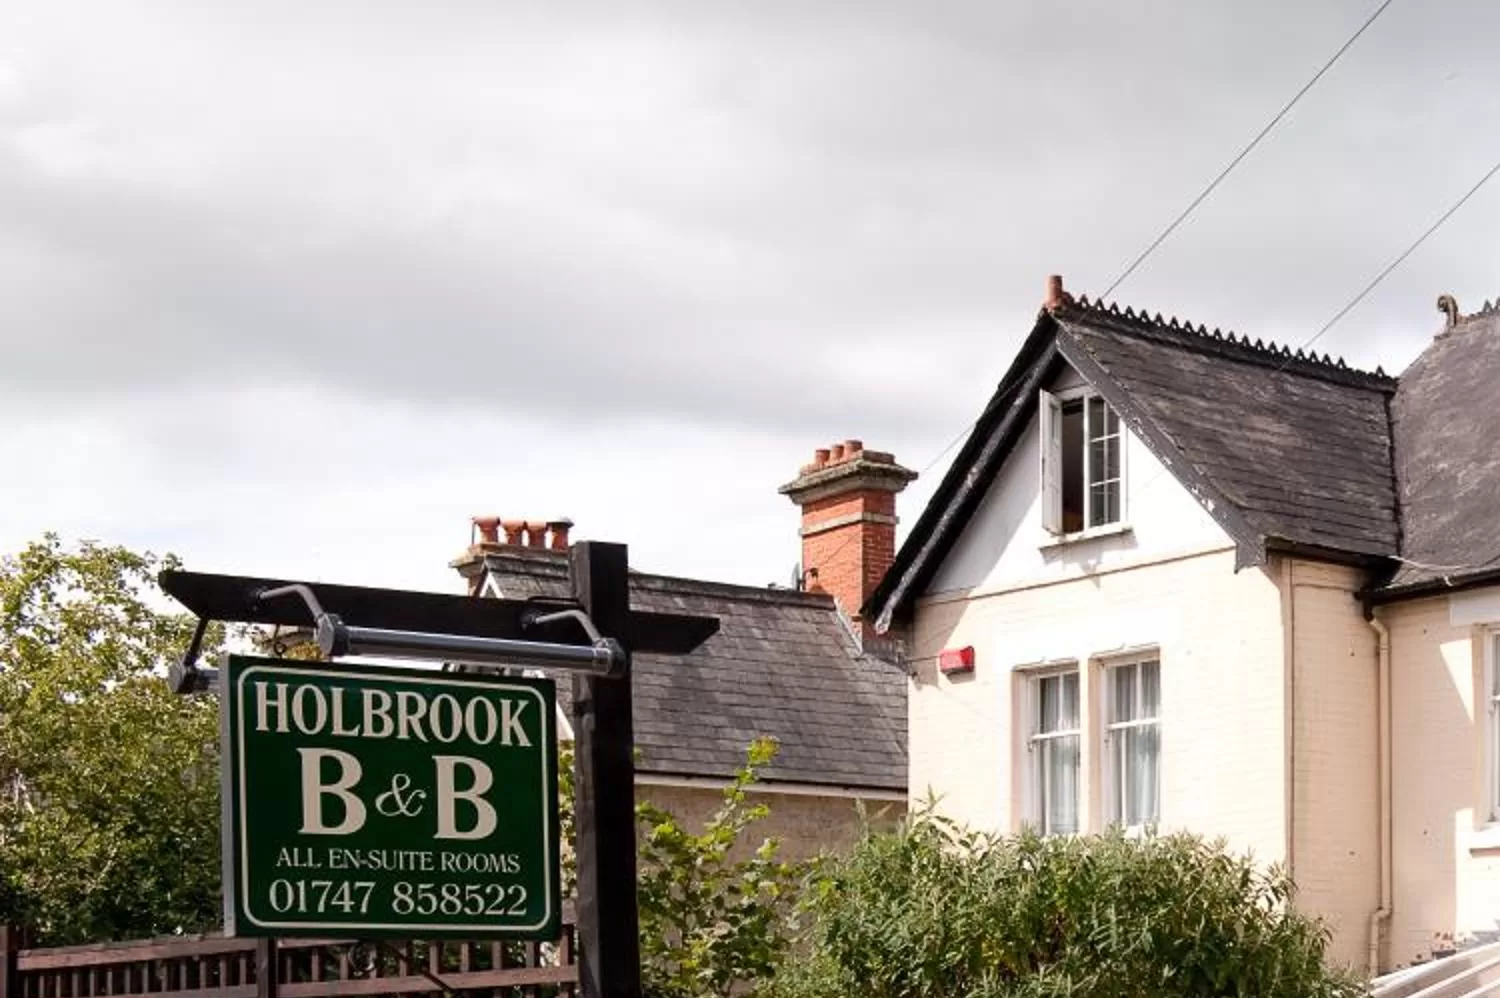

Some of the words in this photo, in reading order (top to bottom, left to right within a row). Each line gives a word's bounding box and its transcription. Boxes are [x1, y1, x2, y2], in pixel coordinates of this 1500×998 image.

[255, 681, 533, 747] HOLBROOK
[296, 747, 367, 836] B
[375, 773, 427, 817] &
[431, 754, 498, 840] B
[276, 847, 323, 869] ALL
[328, 848, 434, 872] EN-SUITE
[441, 852, 521, 874] ROOMS
[269, 878, 376, 913] 01747
[391, 881, 528, 916] 858522
